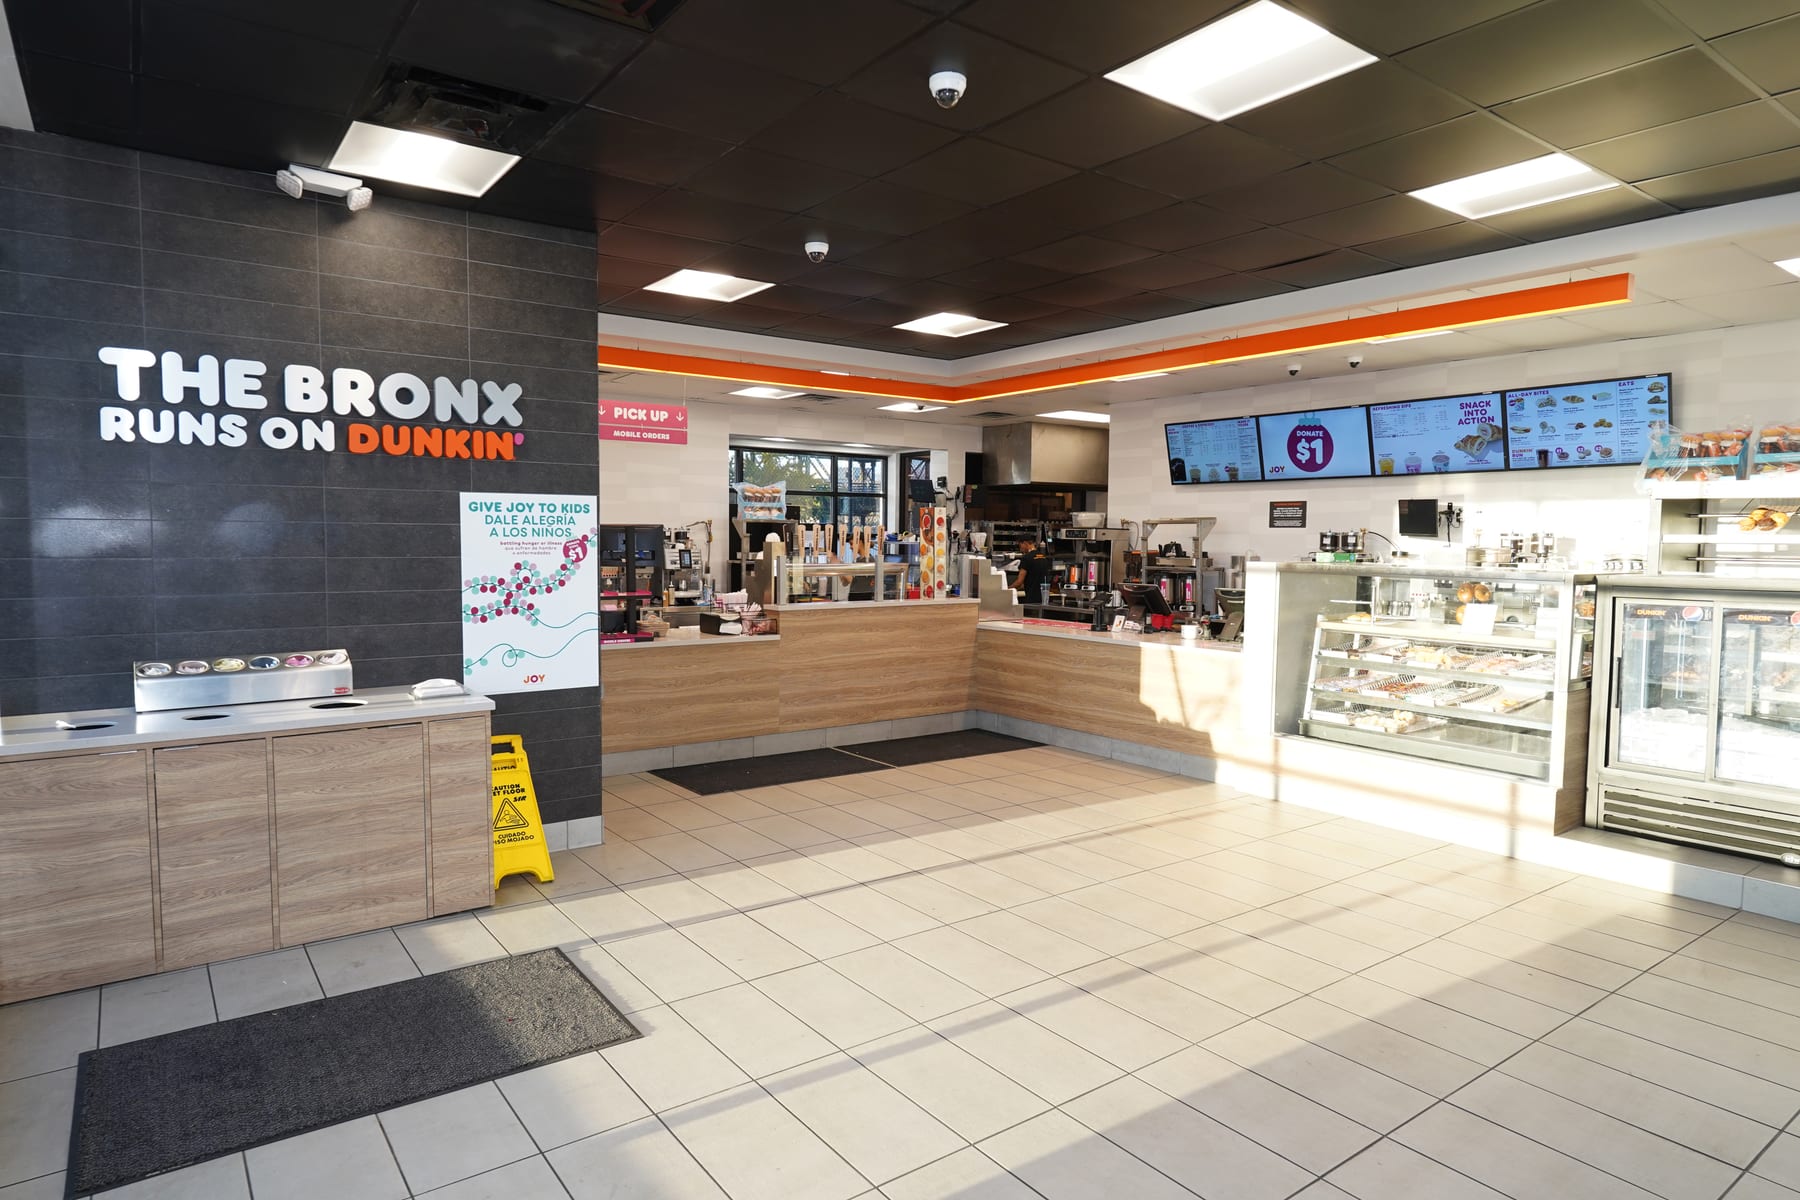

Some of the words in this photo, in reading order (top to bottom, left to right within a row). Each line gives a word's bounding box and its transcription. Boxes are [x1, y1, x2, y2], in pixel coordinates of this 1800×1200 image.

[98, 347, 268, 409] THE
[284, 364, 524, 427] BRONX
[1459, 400, 1492, 410] SNACK
[614, 406, 647, 421] PICK
[650, 410, 669, 422] UP
[1464, 409, 1487, 417] INTO
[1457, 416, 1495, 425] ACTION
[100, 406, 247, 449] RUNS
[260, 416, 336, 453] ON
[348, 423, 525, 461] DUNKIN'
[613, 430, 641, 438] MOBILE
[642, 432, 670, 440] ORDERS
[1296, 438, 1324, 465] $1
[468, 502, 502, 513] GIVE
[506, 502, 534, 513] JOY
[538, 503, 557, 513] TO
[561, 503, 590, 514] KIDS
[485, 515, 517, 525] DALE
[522, 513, 576, 526] ALEGRÍA
[489, 527, 499, 537] A
[503, 527, 527, 538] LOS
[532, 524, 572, 538] NIÑOS
[569, 547, 584, 561] $1
[523, 674, 545, 684] JOY
[498, 831, 526, 839] CUIDADO
[507, 835, 534, 843] MOJADO
